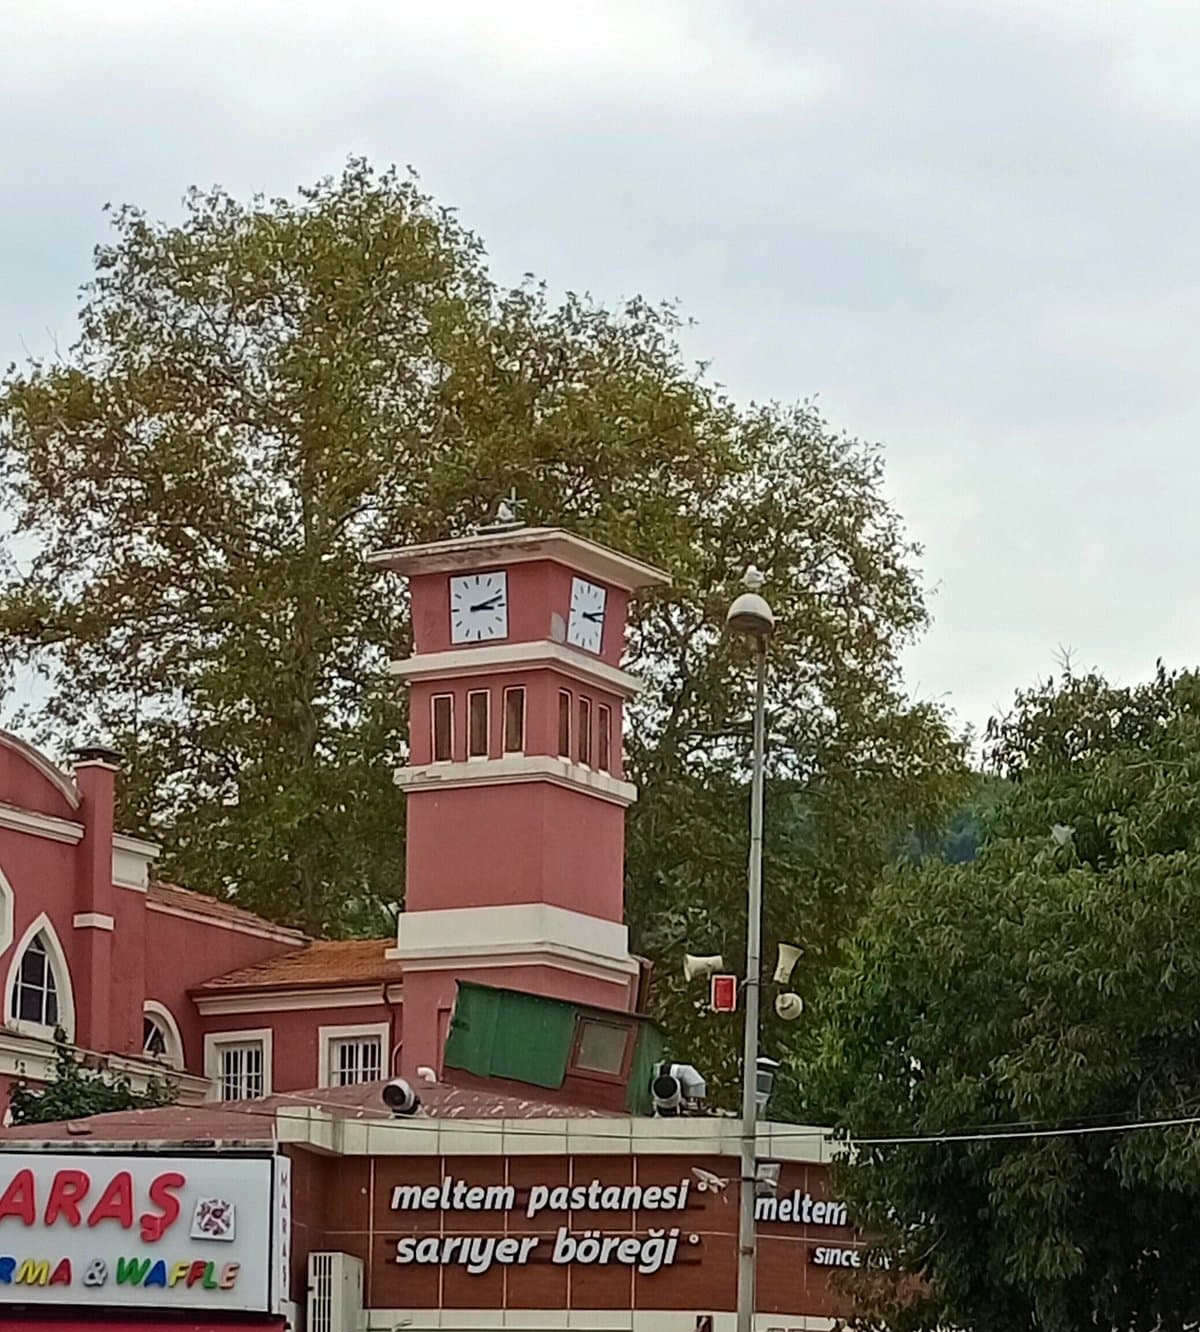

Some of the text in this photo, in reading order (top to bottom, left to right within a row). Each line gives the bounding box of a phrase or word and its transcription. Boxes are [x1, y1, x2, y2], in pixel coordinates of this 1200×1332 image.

[391, 1176, 690, 1218] meltem pastanesi
[754, 1189, 848, 1226] meltem
[395, 1227, 680, 1274] sarıyer böreği
[813, 1246, 861, 1268] since
[83, 1258, 108, 1288] &
[116, 1256, 240, 1290] WAFFLE
